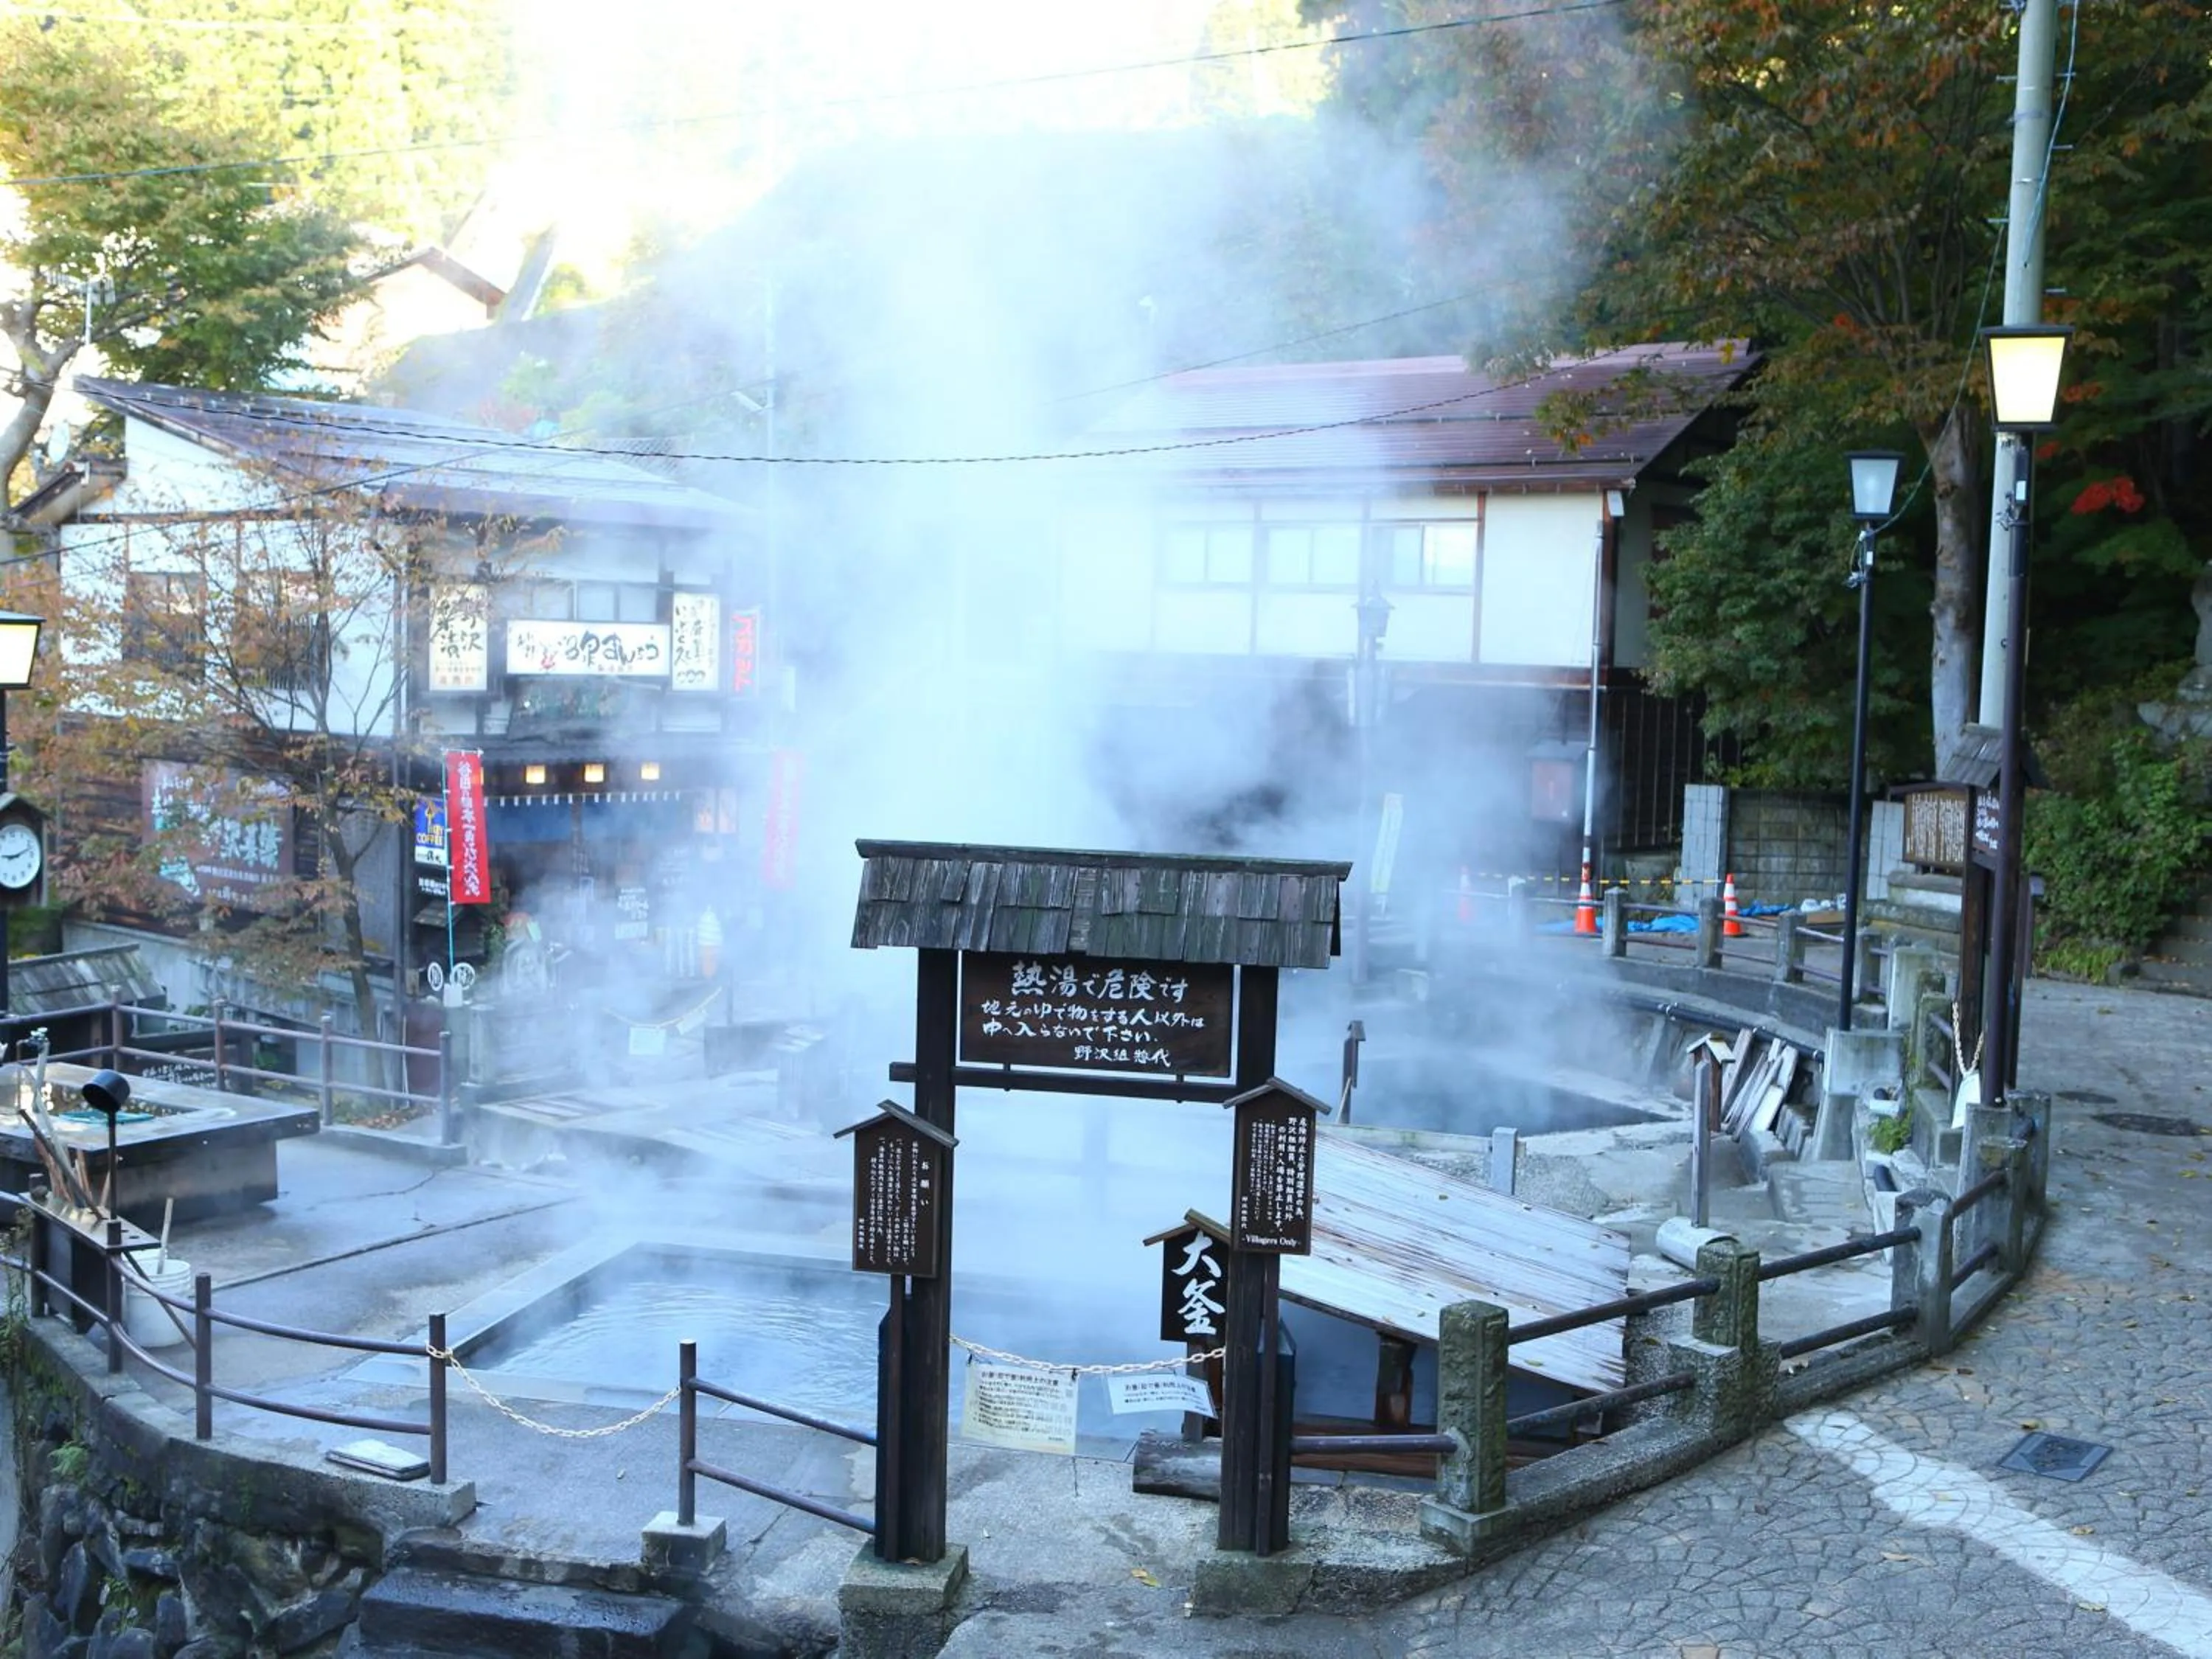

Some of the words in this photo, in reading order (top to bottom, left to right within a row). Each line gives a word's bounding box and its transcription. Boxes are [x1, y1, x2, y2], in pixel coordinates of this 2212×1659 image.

[416, 832, 442, 846] COFFEE
[1011, 960, 1189, 1003] 熱湯で危険です
[981, 1000, 1206, 1029] 地元のゆで物をする人以外は
[919, 1161, 930, 1206] お願い
[1171, 1231, 1225, 1335] 大釜
